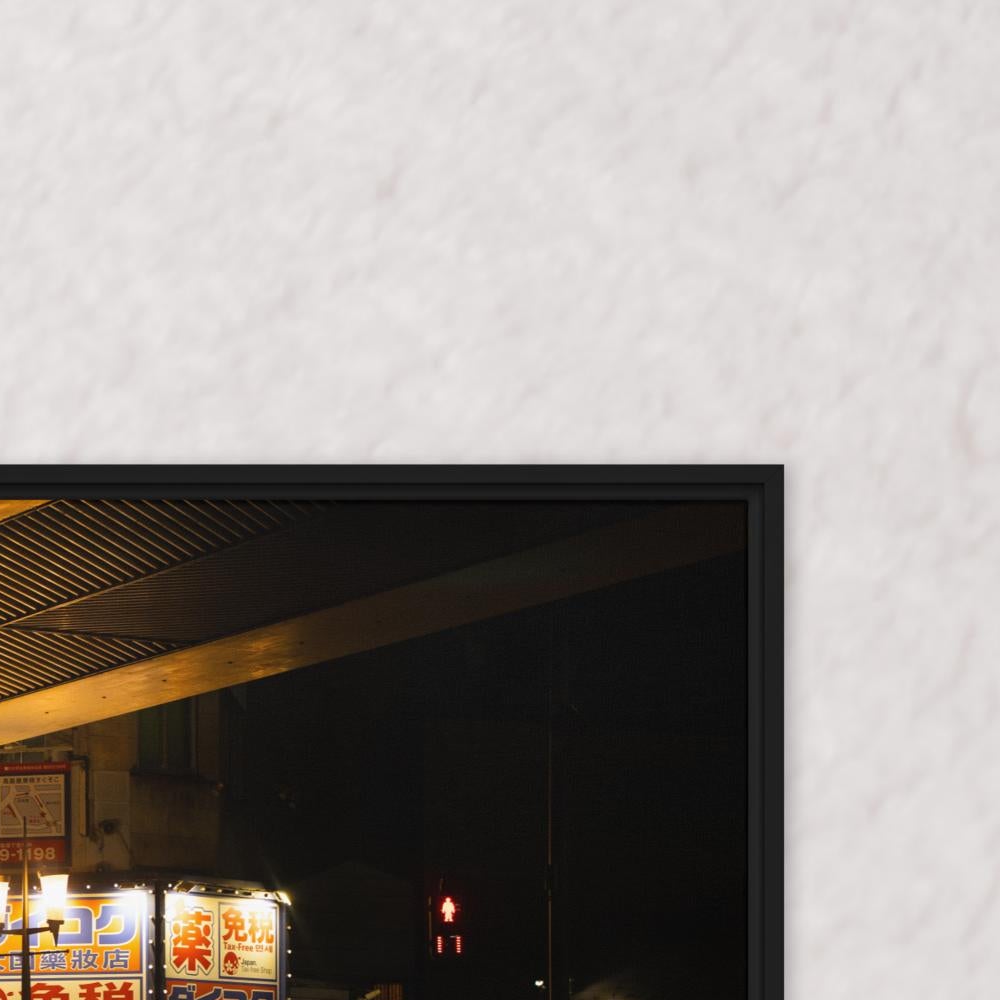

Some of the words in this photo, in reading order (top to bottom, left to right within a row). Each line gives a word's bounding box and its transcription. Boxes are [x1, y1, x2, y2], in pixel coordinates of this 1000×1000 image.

[172, 911, 212, 972] 薬
[222, 907, 274, 943] 免税
[224, 942, 254, 952] Tax-Free
